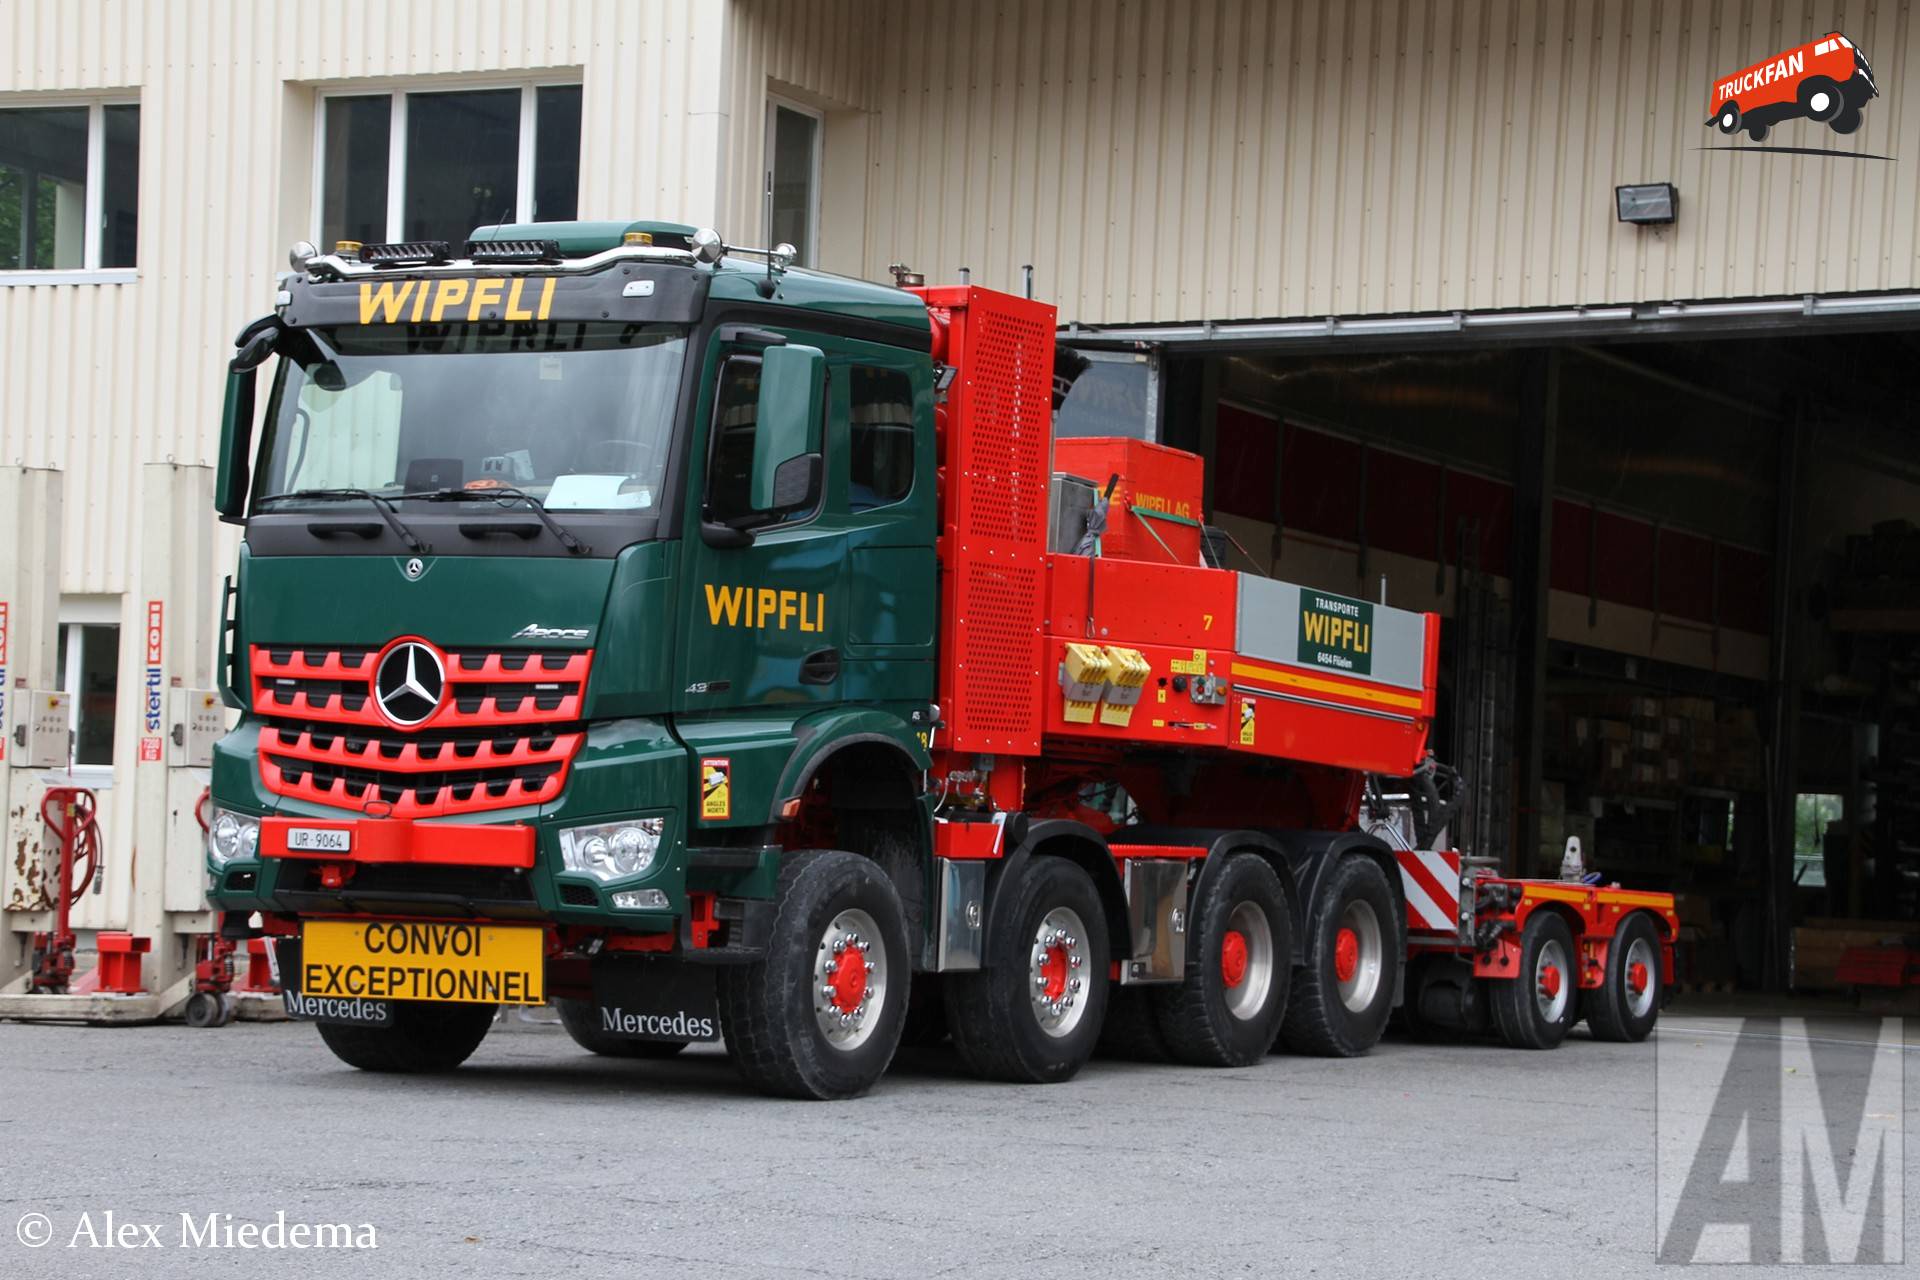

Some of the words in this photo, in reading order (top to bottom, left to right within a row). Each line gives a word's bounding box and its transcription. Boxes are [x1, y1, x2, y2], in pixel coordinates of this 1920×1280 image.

[359, 277, 556, 324] WIPFLI
[704, 584, 824, 633] WIPFLI
[1203, 614, 1213, 631] 7
[1315, 597, 1359, 618] TRANSPORTE
[1303, 610, 1369, 654] WIPFLI
[1317, 651, 1333, 665] 6454
[146, 668, 161, 730] stertil
[364, 922, 481, 957] CONVOI
[305, 964, 540, 1003] EXCEPTIONNEL
[286, 990, 388, 1022] Mercedes
[600, 1006, 714, 1037] Mercedes
